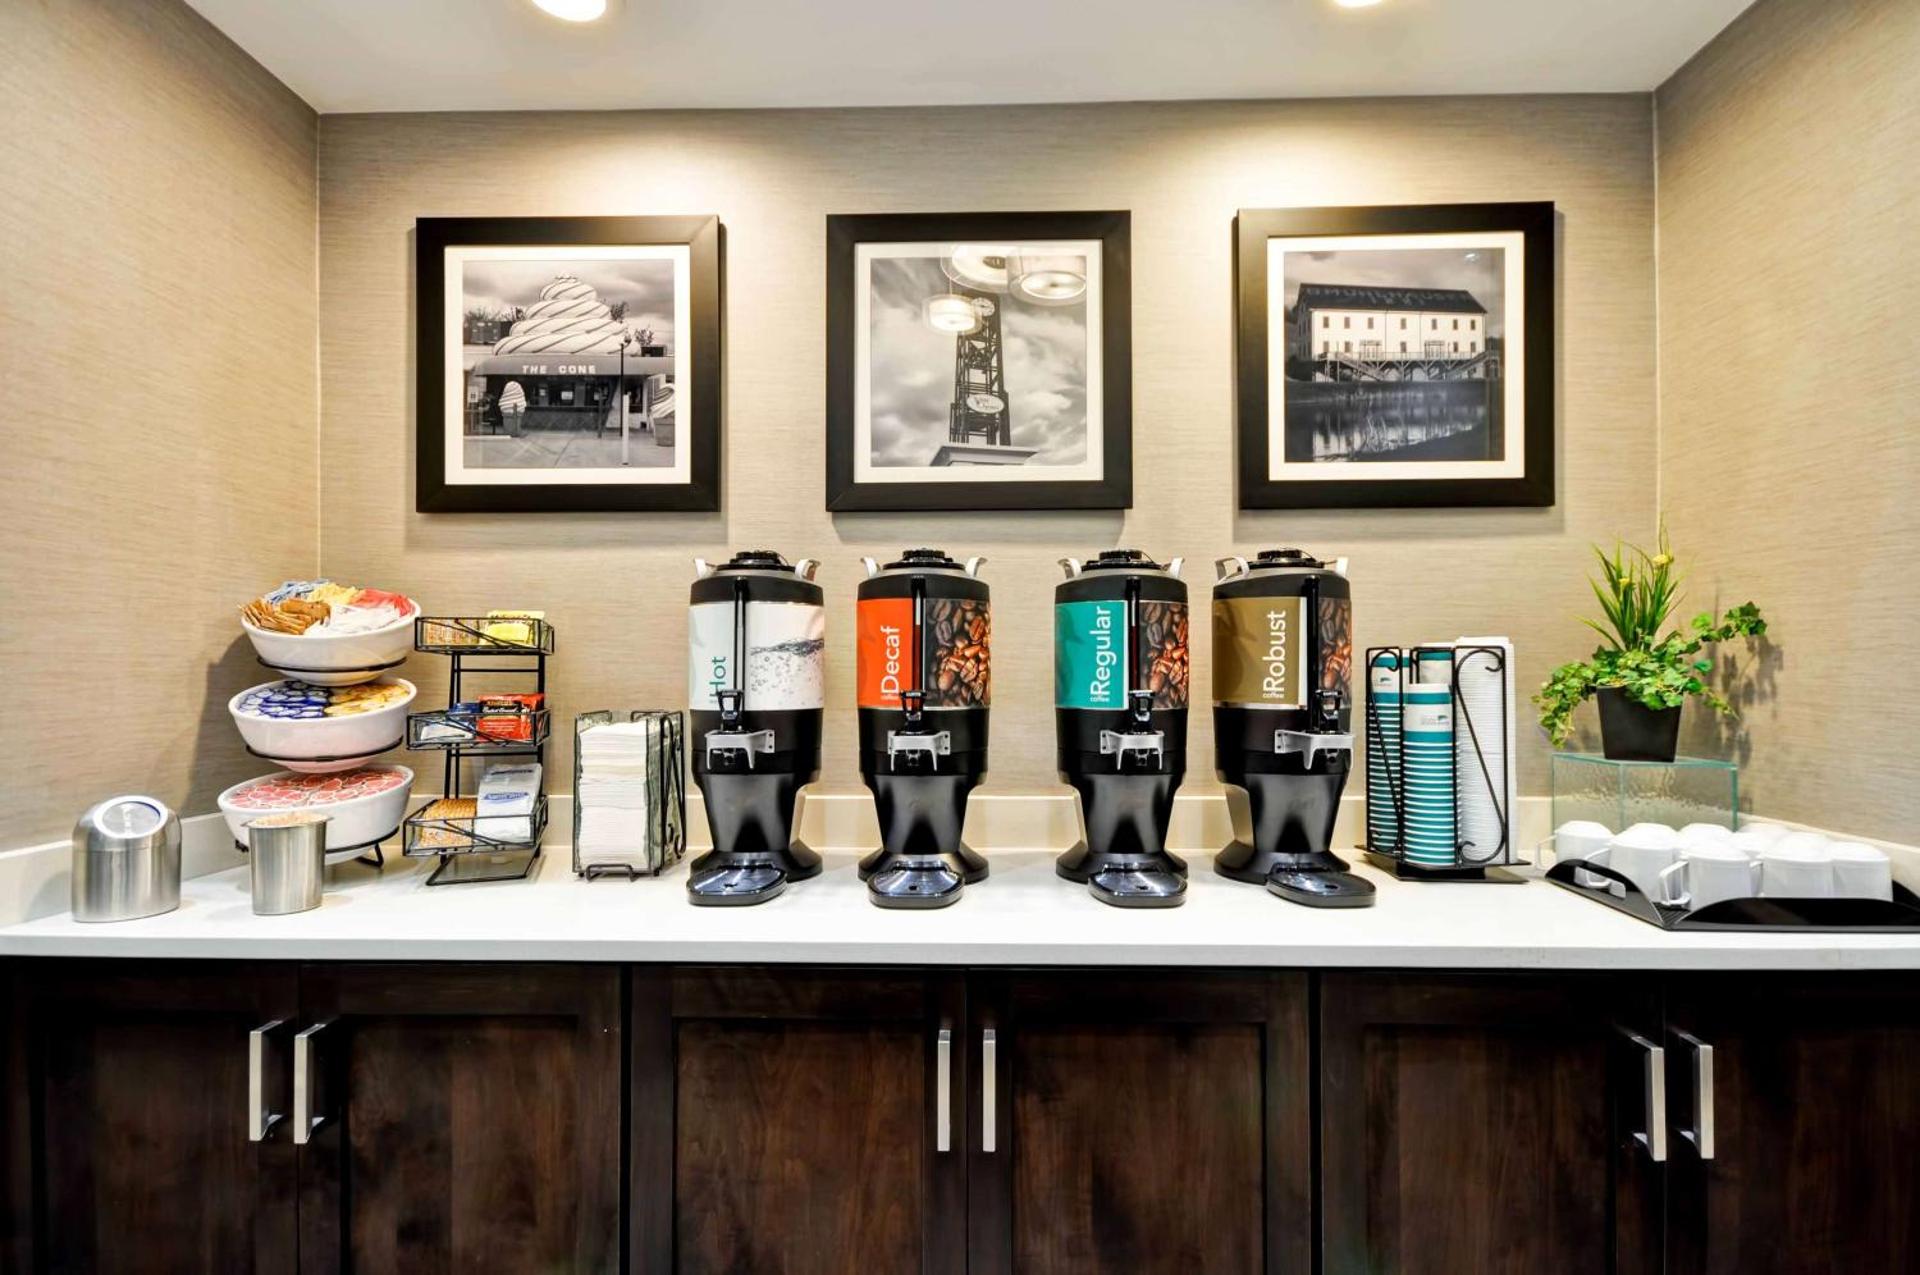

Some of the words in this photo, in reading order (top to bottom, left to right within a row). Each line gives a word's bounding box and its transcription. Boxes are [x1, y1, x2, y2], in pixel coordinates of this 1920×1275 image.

[522, 365, 547, 375] THE
[558, 364, 596, 375] CONE
[709, 656, 727, 697] Hot
[880, 625, 900, 694] Decaf
[1089, 605, 1117, 695] Regular
[1262, 610, 1287, 691] Robust
